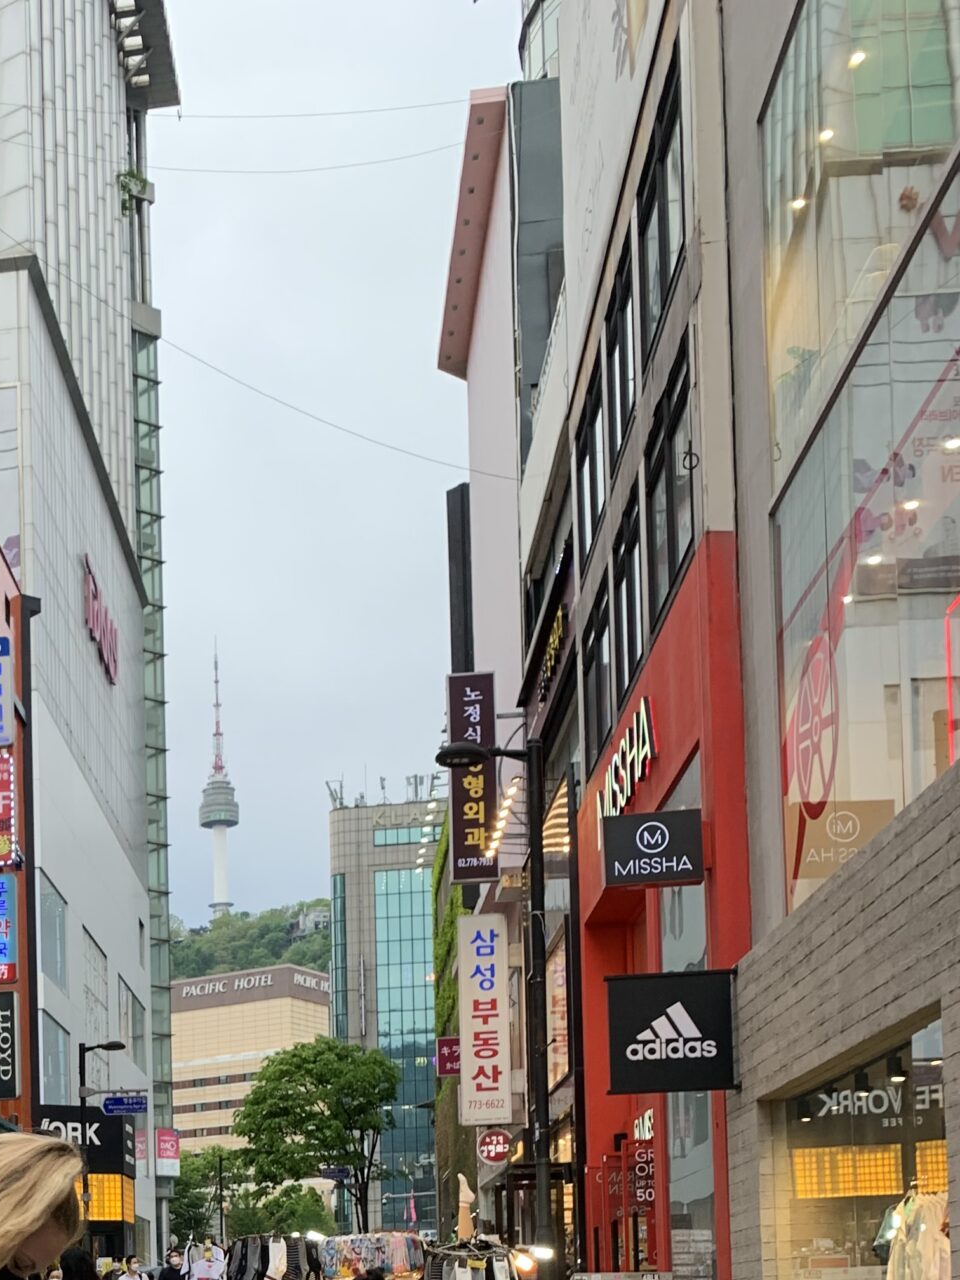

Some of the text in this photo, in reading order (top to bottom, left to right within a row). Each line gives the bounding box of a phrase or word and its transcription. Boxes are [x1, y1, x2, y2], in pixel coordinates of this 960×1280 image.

[463, 688, 483, 744] 노정식
[596, 696, 651, 851] MISSHA
[372, 807, 438, 827] KLA
[614, 855, 693, 877] MISSHA
[470, 928, 500, 991] 삼성
[182, 974, 274, 998] PACIFIC HOTEL
[294, 973, 319, 990] PACIFIC
[472, 998, 502, 1092] 부동산
[625, 1036, 718, 1062] adidas
[468, 1100, 505, 1111] 773-6622
[636, 1188, 656, 1201] 50
